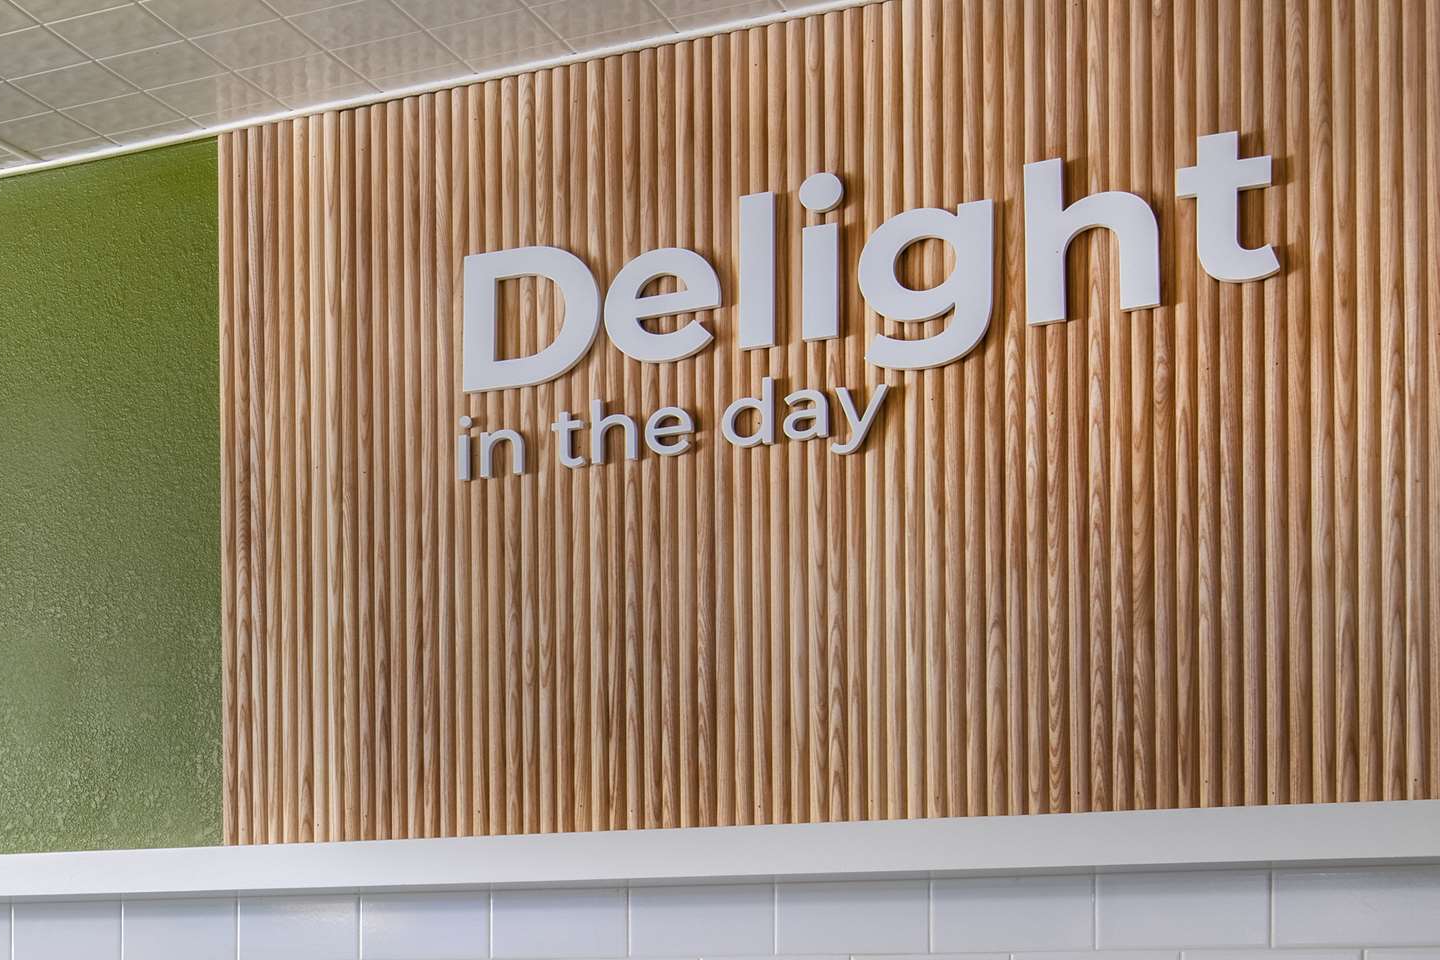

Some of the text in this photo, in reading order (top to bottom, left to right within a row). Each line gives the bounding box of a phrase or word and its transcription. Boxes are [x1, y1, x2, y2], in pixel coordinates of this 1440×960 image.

[462, 129, 1282, 394] Delight
[457, 376, 891, 483] in the day
